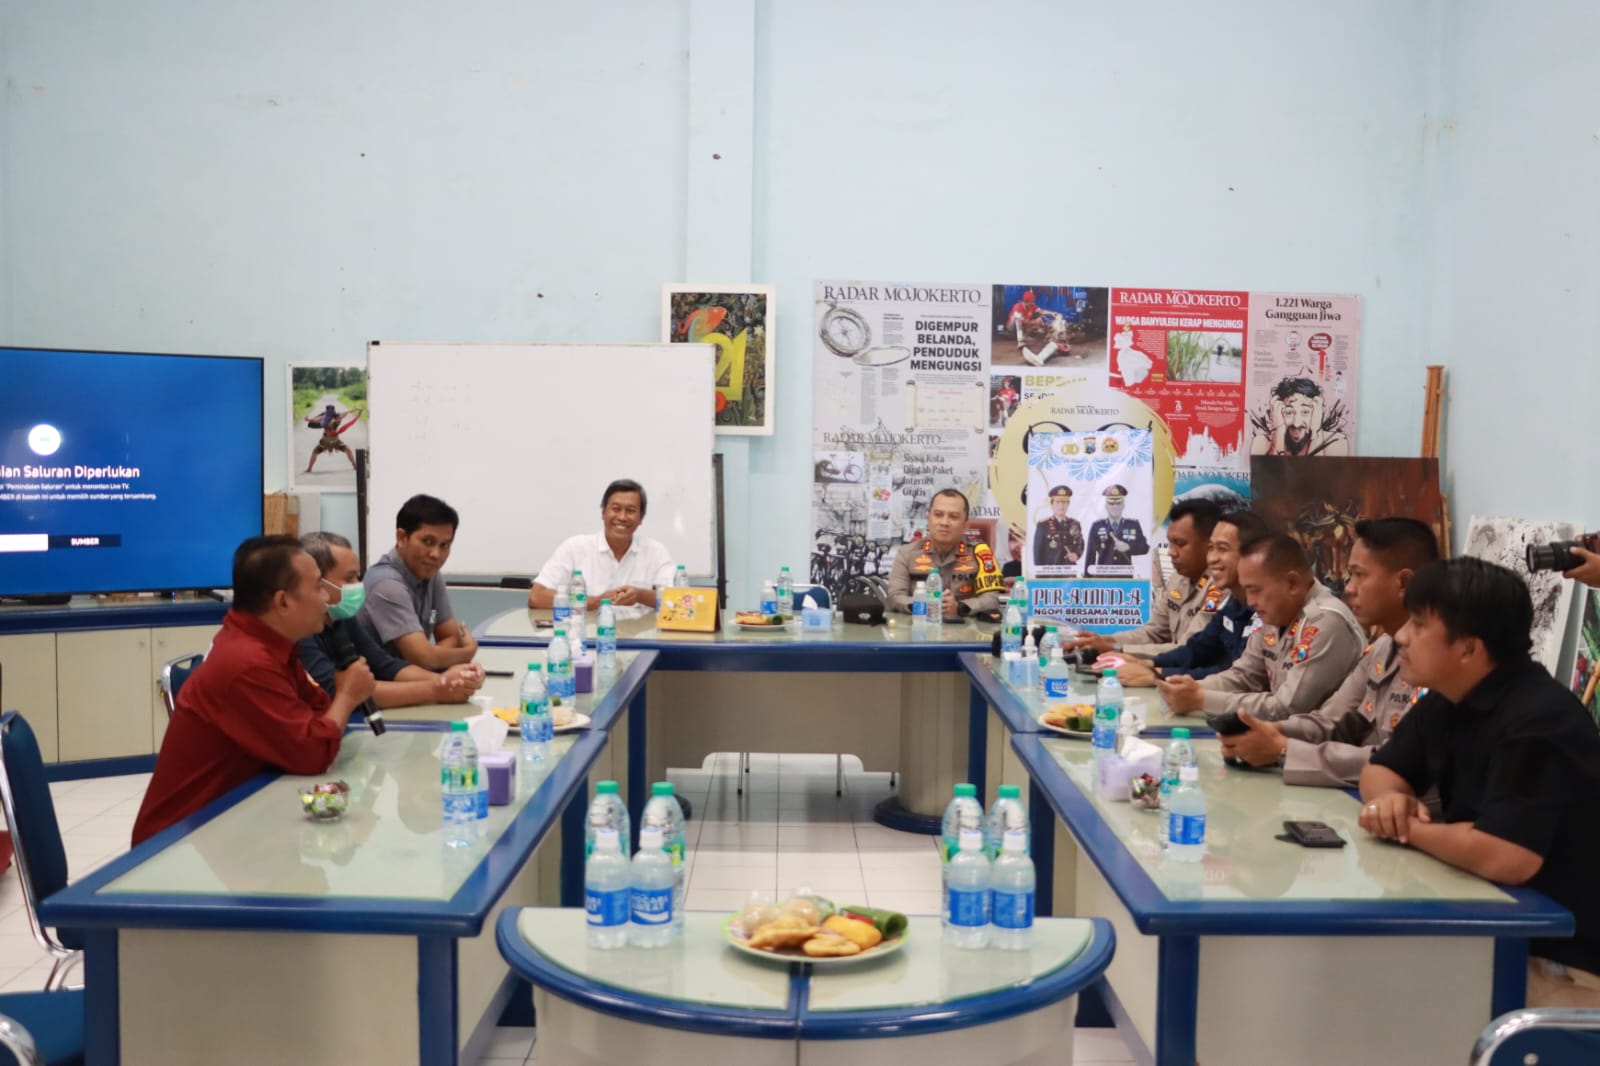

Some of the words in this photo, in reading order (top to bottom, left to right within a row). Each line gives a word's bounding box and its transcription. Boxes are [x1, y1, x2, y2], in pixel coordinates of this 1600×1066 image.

[824, 286, 879, 301] RADAR
[884, 287, 981, 303] MOJOKERTO
[1120, 291, 1163, 304] RADAR
[1166, 292, 1241, 307] MOJOKERTO
[1300, 298, 1332, 310] Warga
[1265, 309, 1318, 322] Gangguan
[1319, 310, 1342, 322] Jiwa
[915, 320, 979, 333] DIGEMPUR
[1202, 318, 1244, 329] MENGUNGSI
[917, 334, 976, 346] BELANDA,
[913, 346, 979, 359] PENDUDUK
[910, 359, 982, 372] MENGUNGSI
[23, 465, 72, 478] Saluran
[74, 465, 140, 480] Diperlukan
[71, 537, 99, 546] SUMBER
[1034, 608, 1063, 616] NGOPI
[1065, 608, 1108, 616] BERSAMA
[1110, 608, 1140, 616] MEDIA
